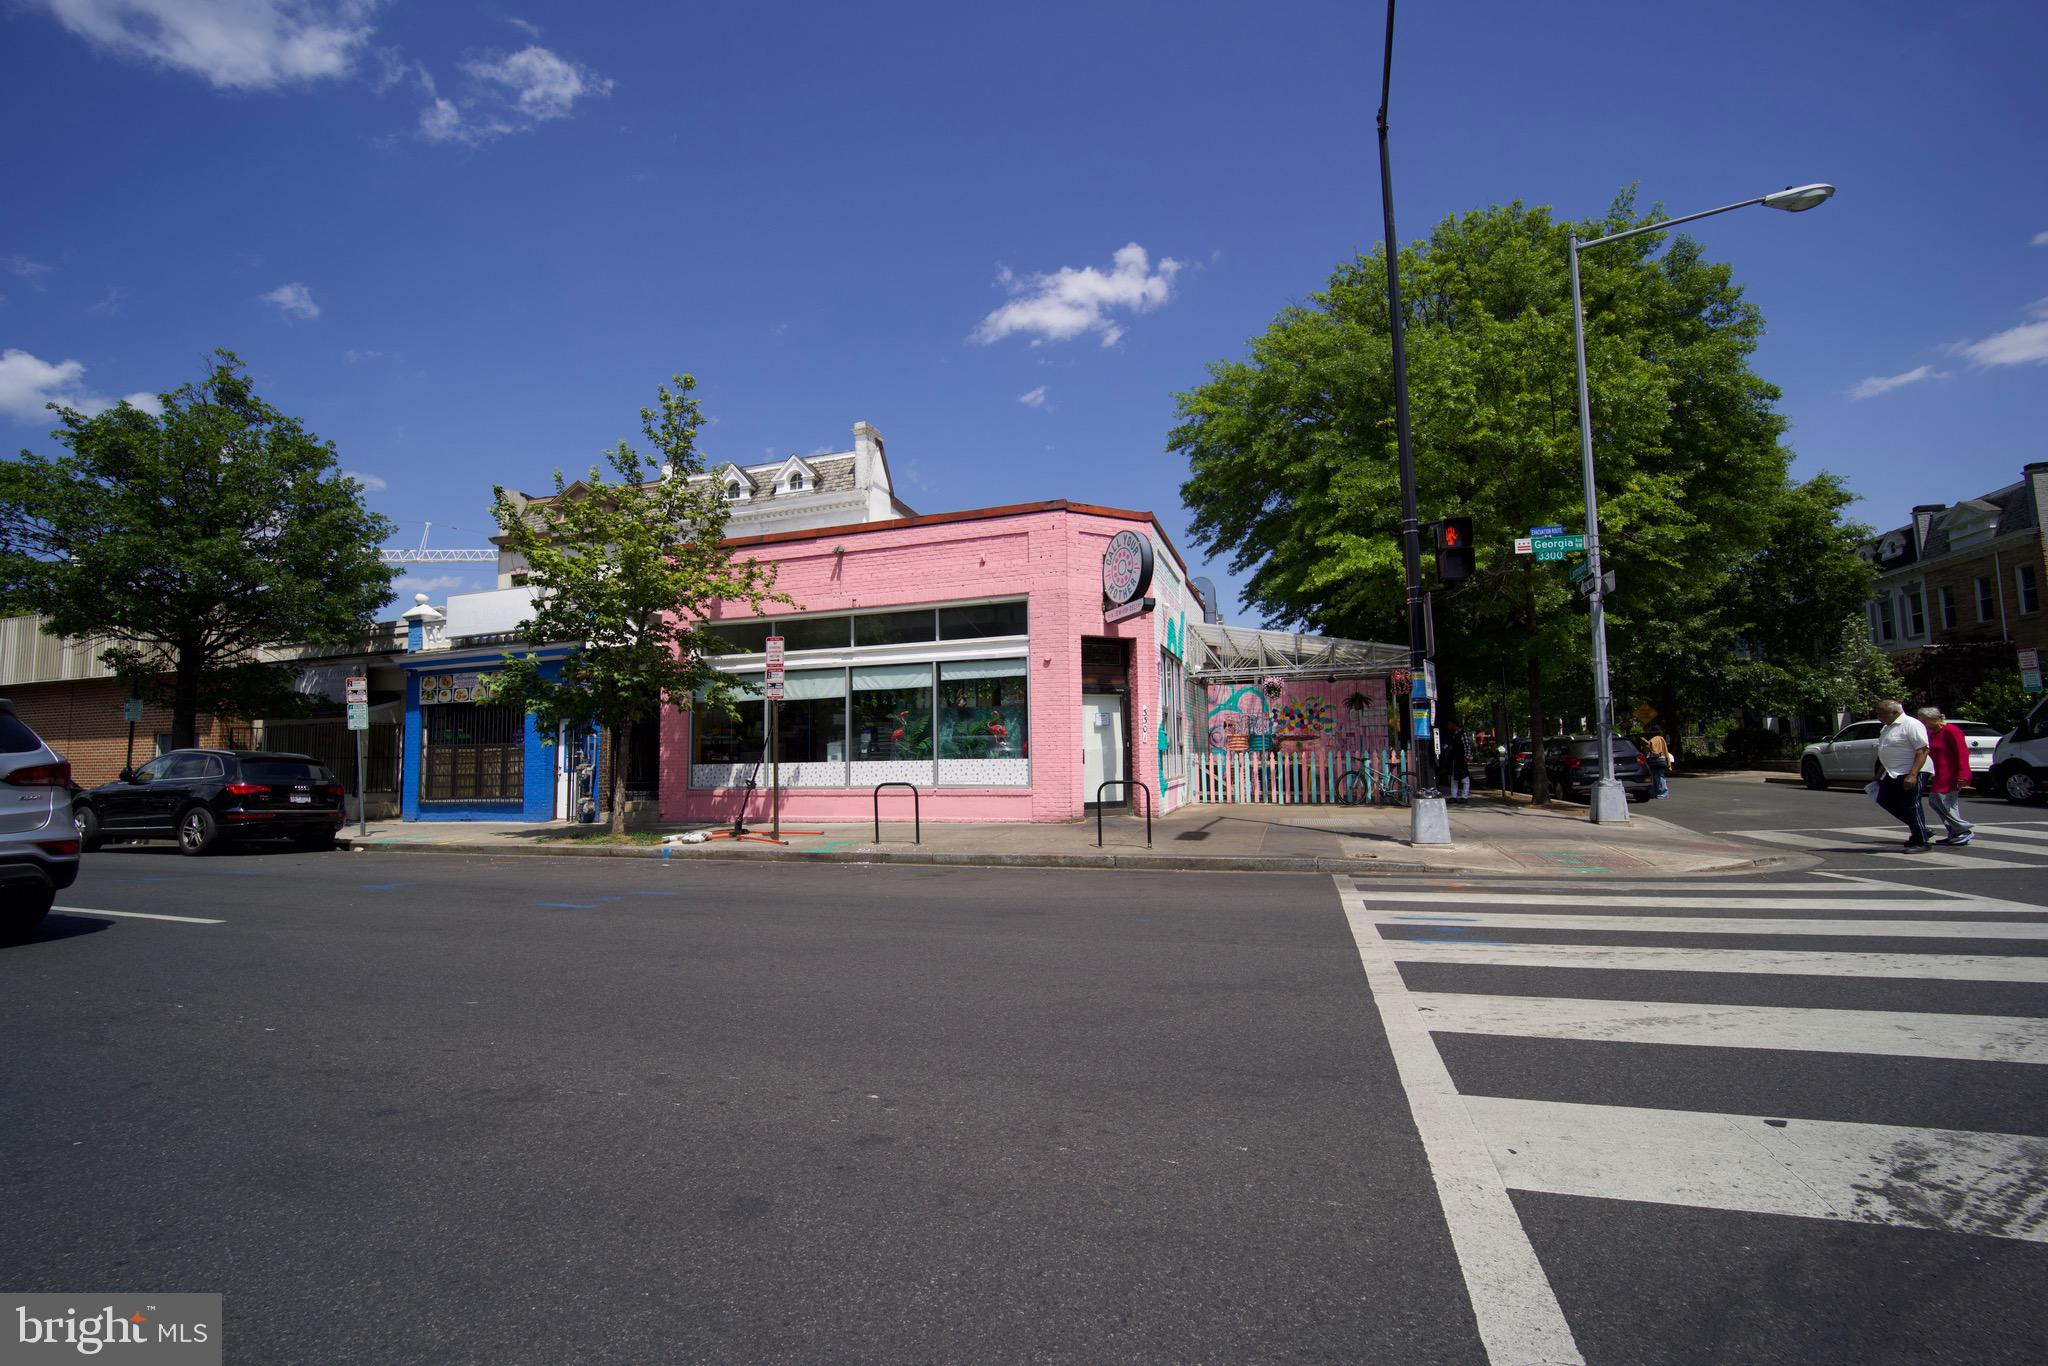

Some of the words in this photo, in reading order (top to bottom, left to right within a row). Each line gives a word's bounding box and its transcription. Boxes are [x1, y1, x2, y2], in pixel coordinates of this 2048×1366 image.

[1531, 528, 1551, 536] EVACUATION
[1106, 538, 1121, 566] CALL
[1123, 534, 1139, 557] YOUR
[1534, 538, 1574, 550] Georgia
[1538, 551, 1563, 560] 3300
[1108, 577, 1137, 601] MOTHER
